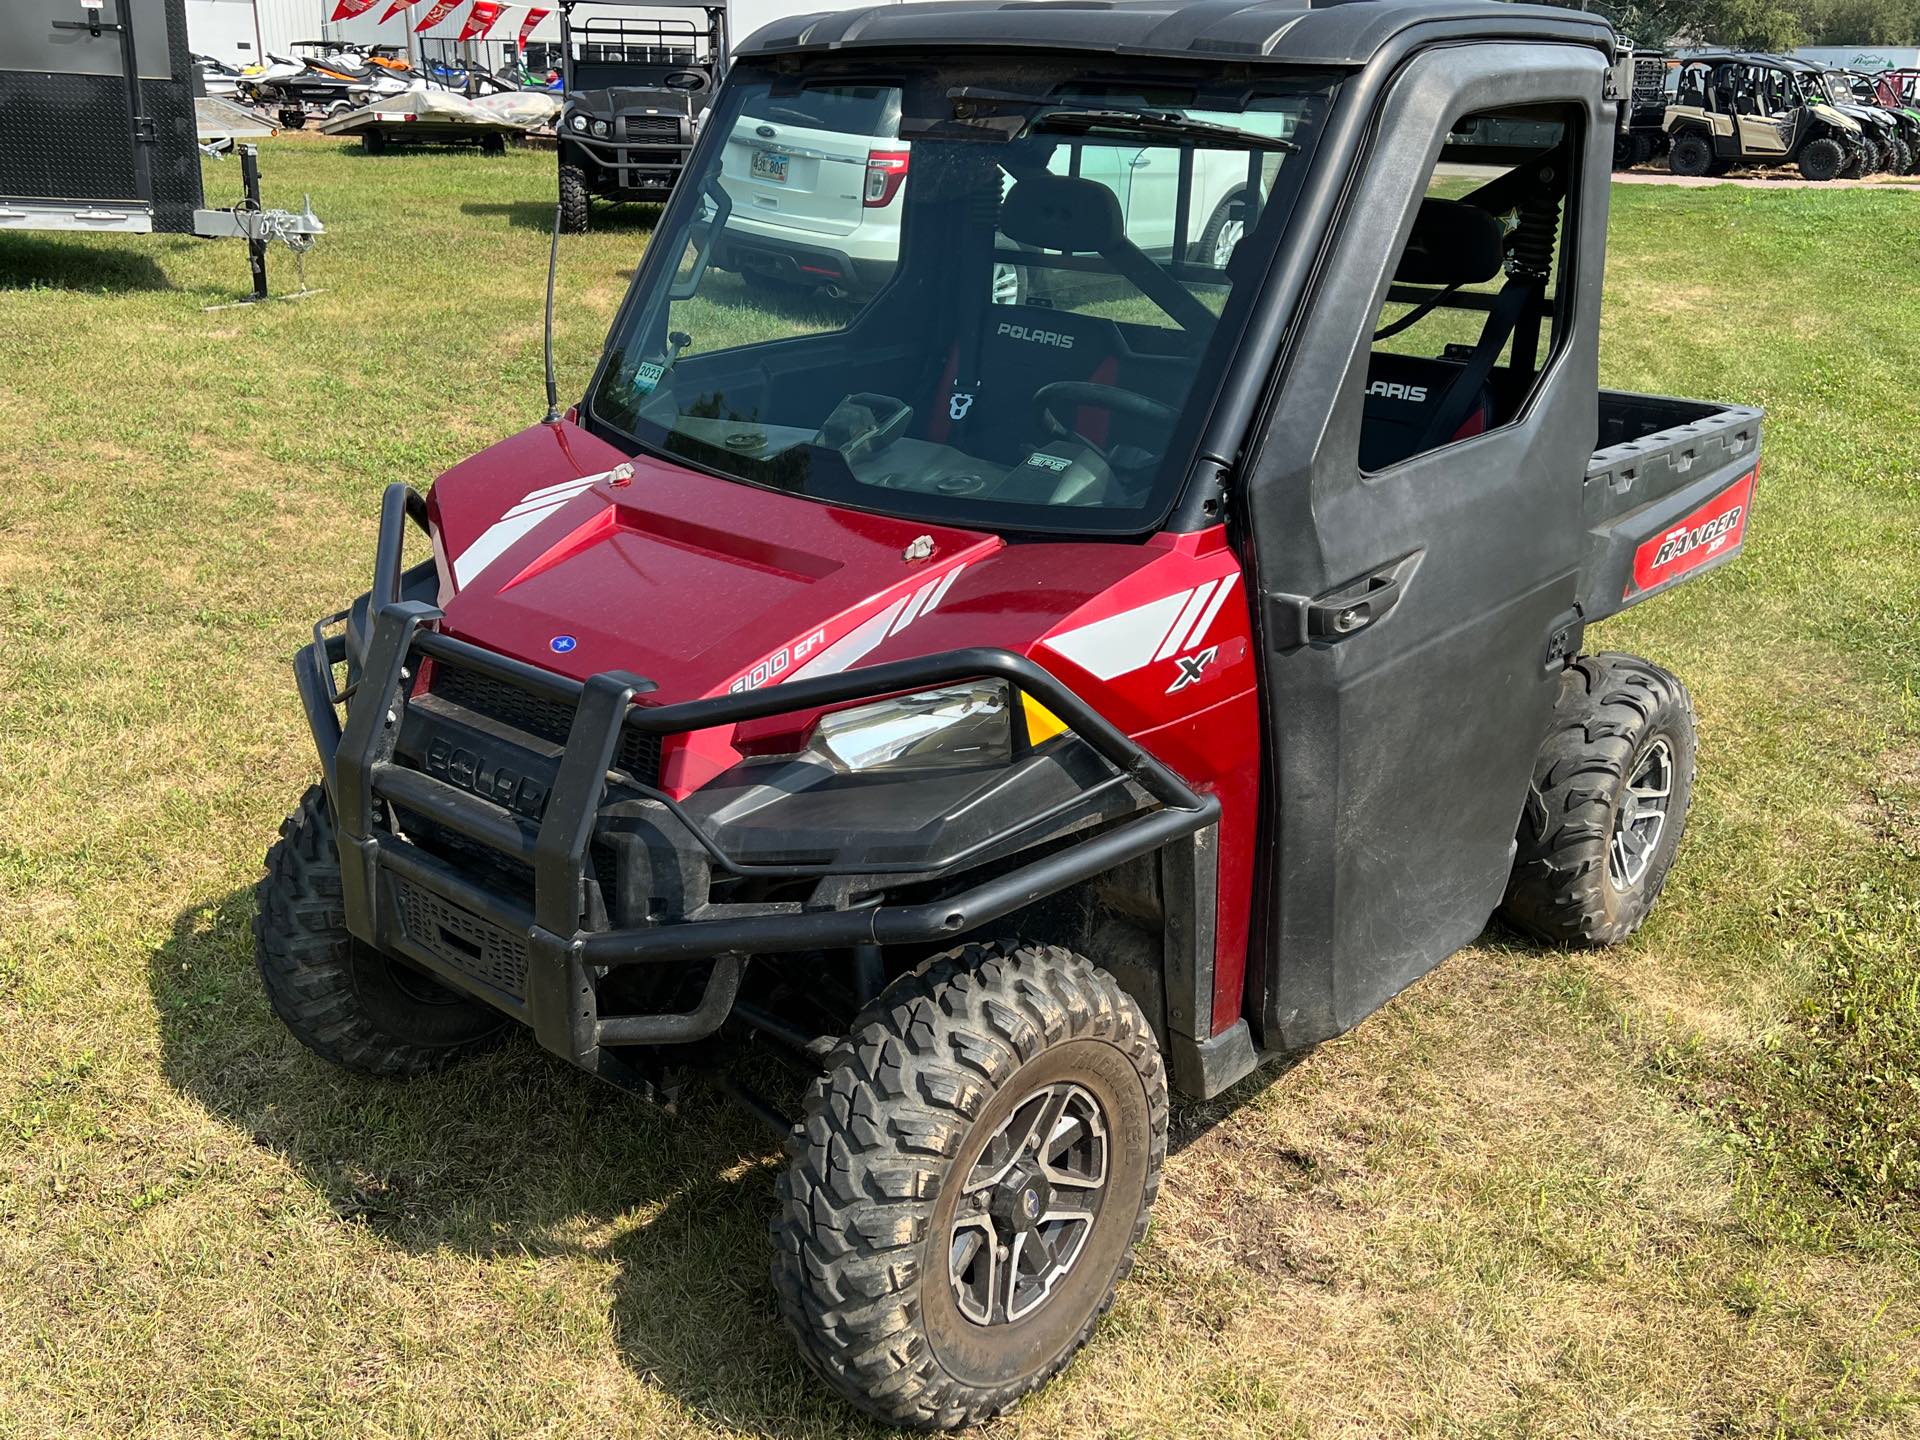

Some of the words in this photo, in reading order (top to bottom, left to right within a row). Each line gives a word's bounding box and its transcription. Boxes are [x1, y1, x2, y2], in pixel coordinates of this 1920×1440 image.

[997, 322, 1075, 349] POLARIS
[639, 365, 661, 380] 2023
[1027, 455, 1068, 471] EPS
[1651, 505, 1742, 569] RANGER
[794, 628, 824, 660] EFI
[425, 736, 553, 820] POLAR
